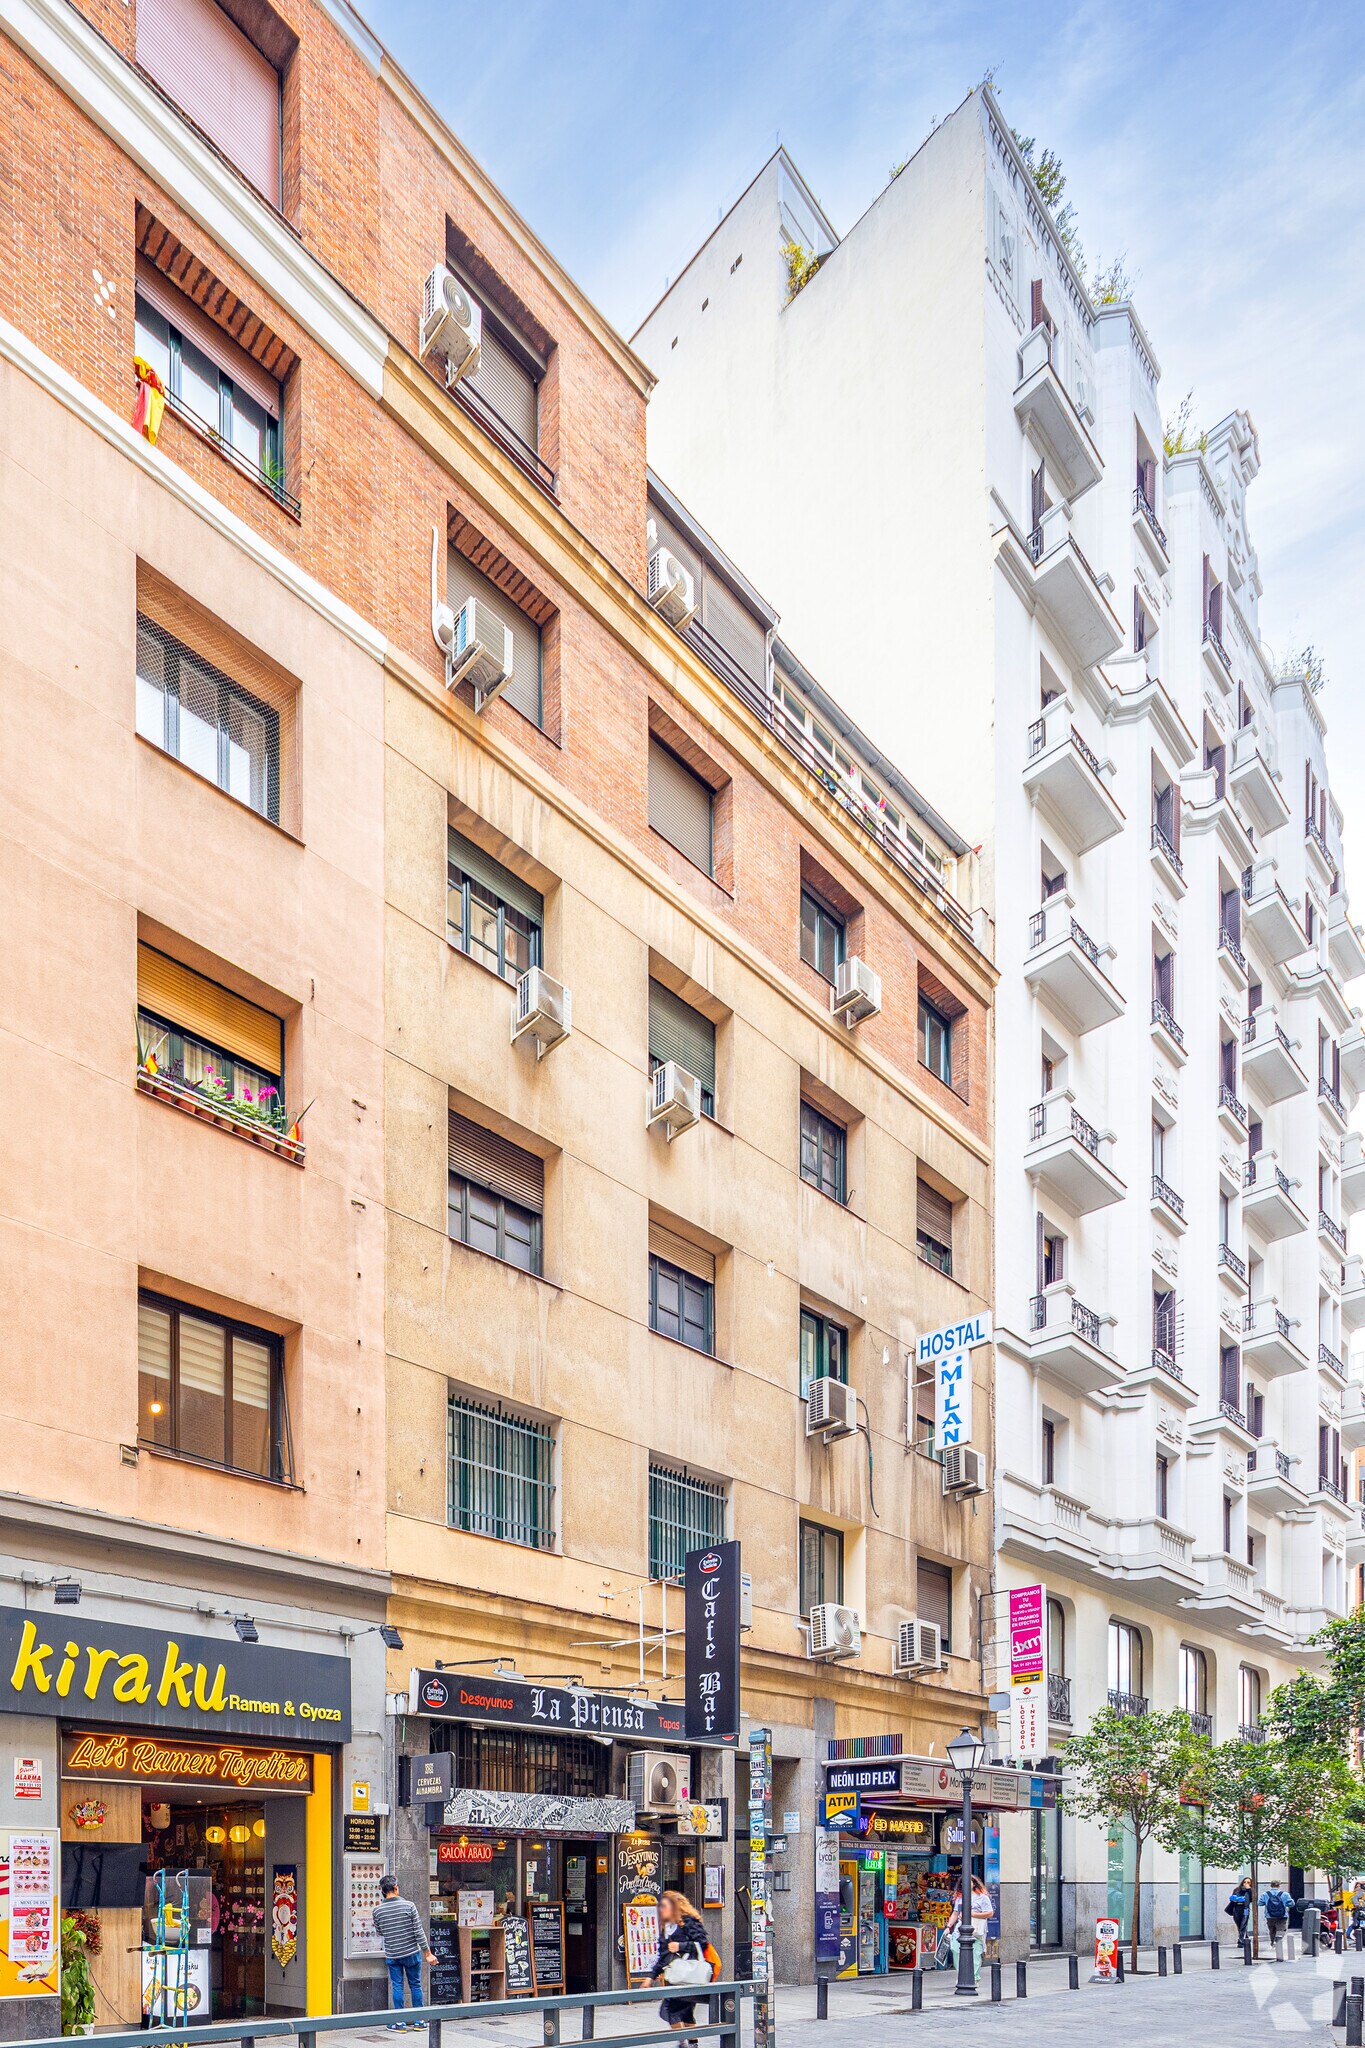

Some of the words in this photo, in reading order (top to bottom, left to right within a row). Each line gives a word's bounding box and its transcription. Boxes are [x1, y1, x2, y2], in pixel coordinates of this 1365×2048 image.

[920, 1319, 986, 1360] HOSTAL
[940, 1364, 963, 1446] MILAN
[1011, 1588, 1041, 1600] COMPRAMOS
[701, 1577, 721, 1660] Cafe
[1018, 1613, 1040, 1622] PAGAMOS
[1018, 1619, 1040, 1627] EFECTIVO
[1012, 1635, 1042, 1655] dxm
[10, 1619, 229, 1712] kiraku
[229, 1694, 280, 1715] Ramen
[284, 1700, 295, 1716] &
[299, 1702, 342, 1722] Gyoza
[460, 1689, 514, 1711] Desayunos
[530, 1688, 561, 1721] La
[569, 1693, 645, 1729] Prensa
[699, 1671, 721, 1732] Bar
[657, 1716, 680, 1732] Tapas
[68, 1736, 128, 1769] Let's
[132, 1742, 218, 1774] Ramen
[219, 1749, 308, 1786] Together
[417, 1776, 442, 1787] CERVEZAS
[830, 1770, 855, 1788] NEÓN
[856, 1772, 871, 1786] LED
[872, 1770, 896, 1786] FLEX
[950, 1776, 987, 1791] MonGram
[415, 1785, 443, 1796] ALHAMBRA
[828, 1796, 855, 1807] ATM
[350, 1818, 375, 1826] HORARIO
[889, 1820, 924, 1833] MADRID
[947, 1825, 976, 1844] Salun
[441, 1847, 466, 1859] SALON
[467, 1847, 492, 1859] ABAJO
[818, 1852, 833, 1862] Lyca
